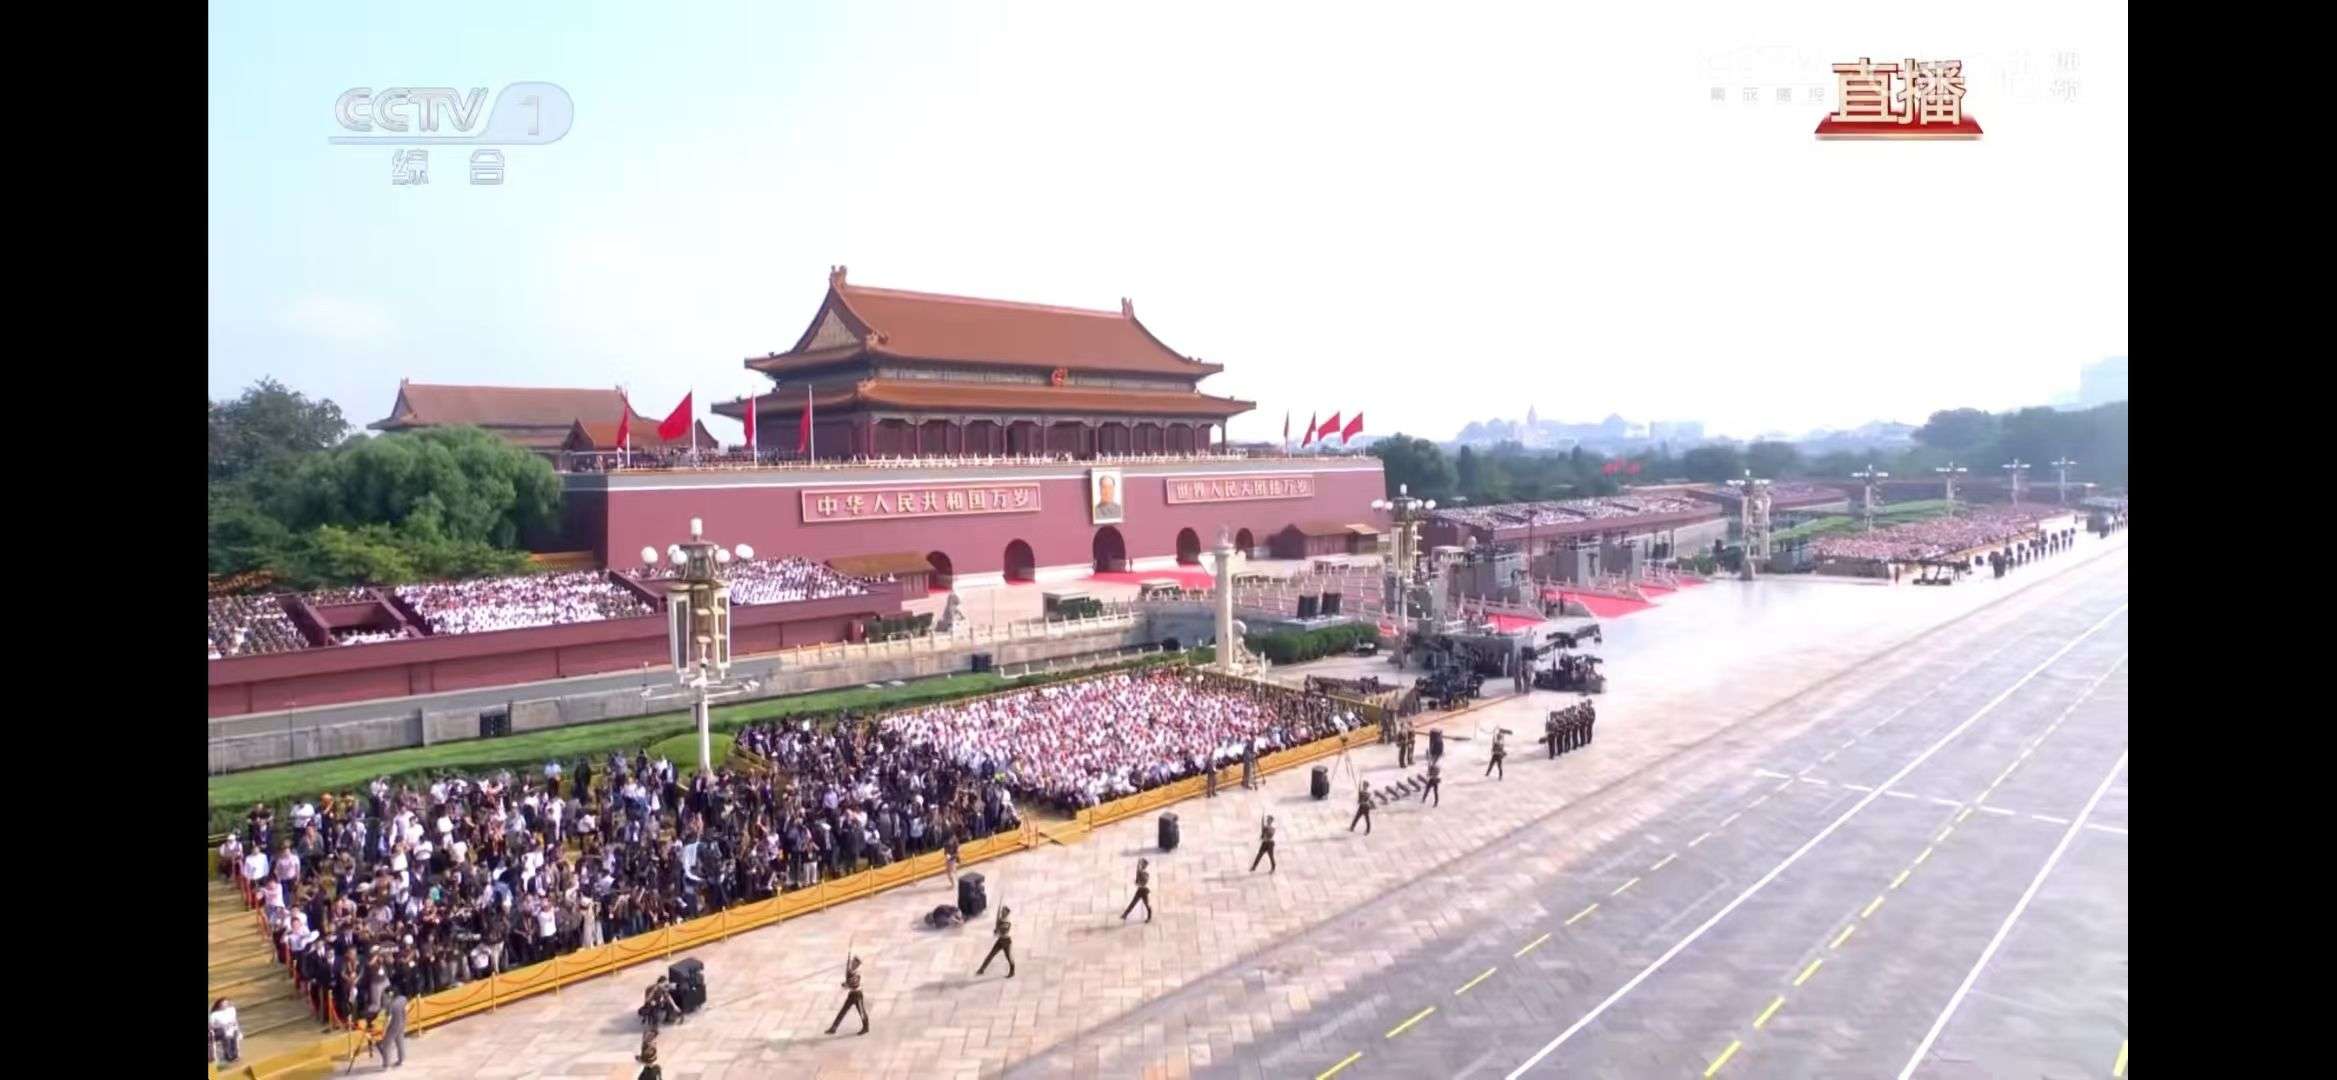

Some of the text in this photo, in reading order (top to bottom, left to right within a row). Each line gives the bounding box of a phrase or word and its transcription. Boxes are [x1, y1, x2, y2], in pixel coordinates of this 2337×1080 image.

[816, 488, 1030, 516] 中华人民共和国万岁
